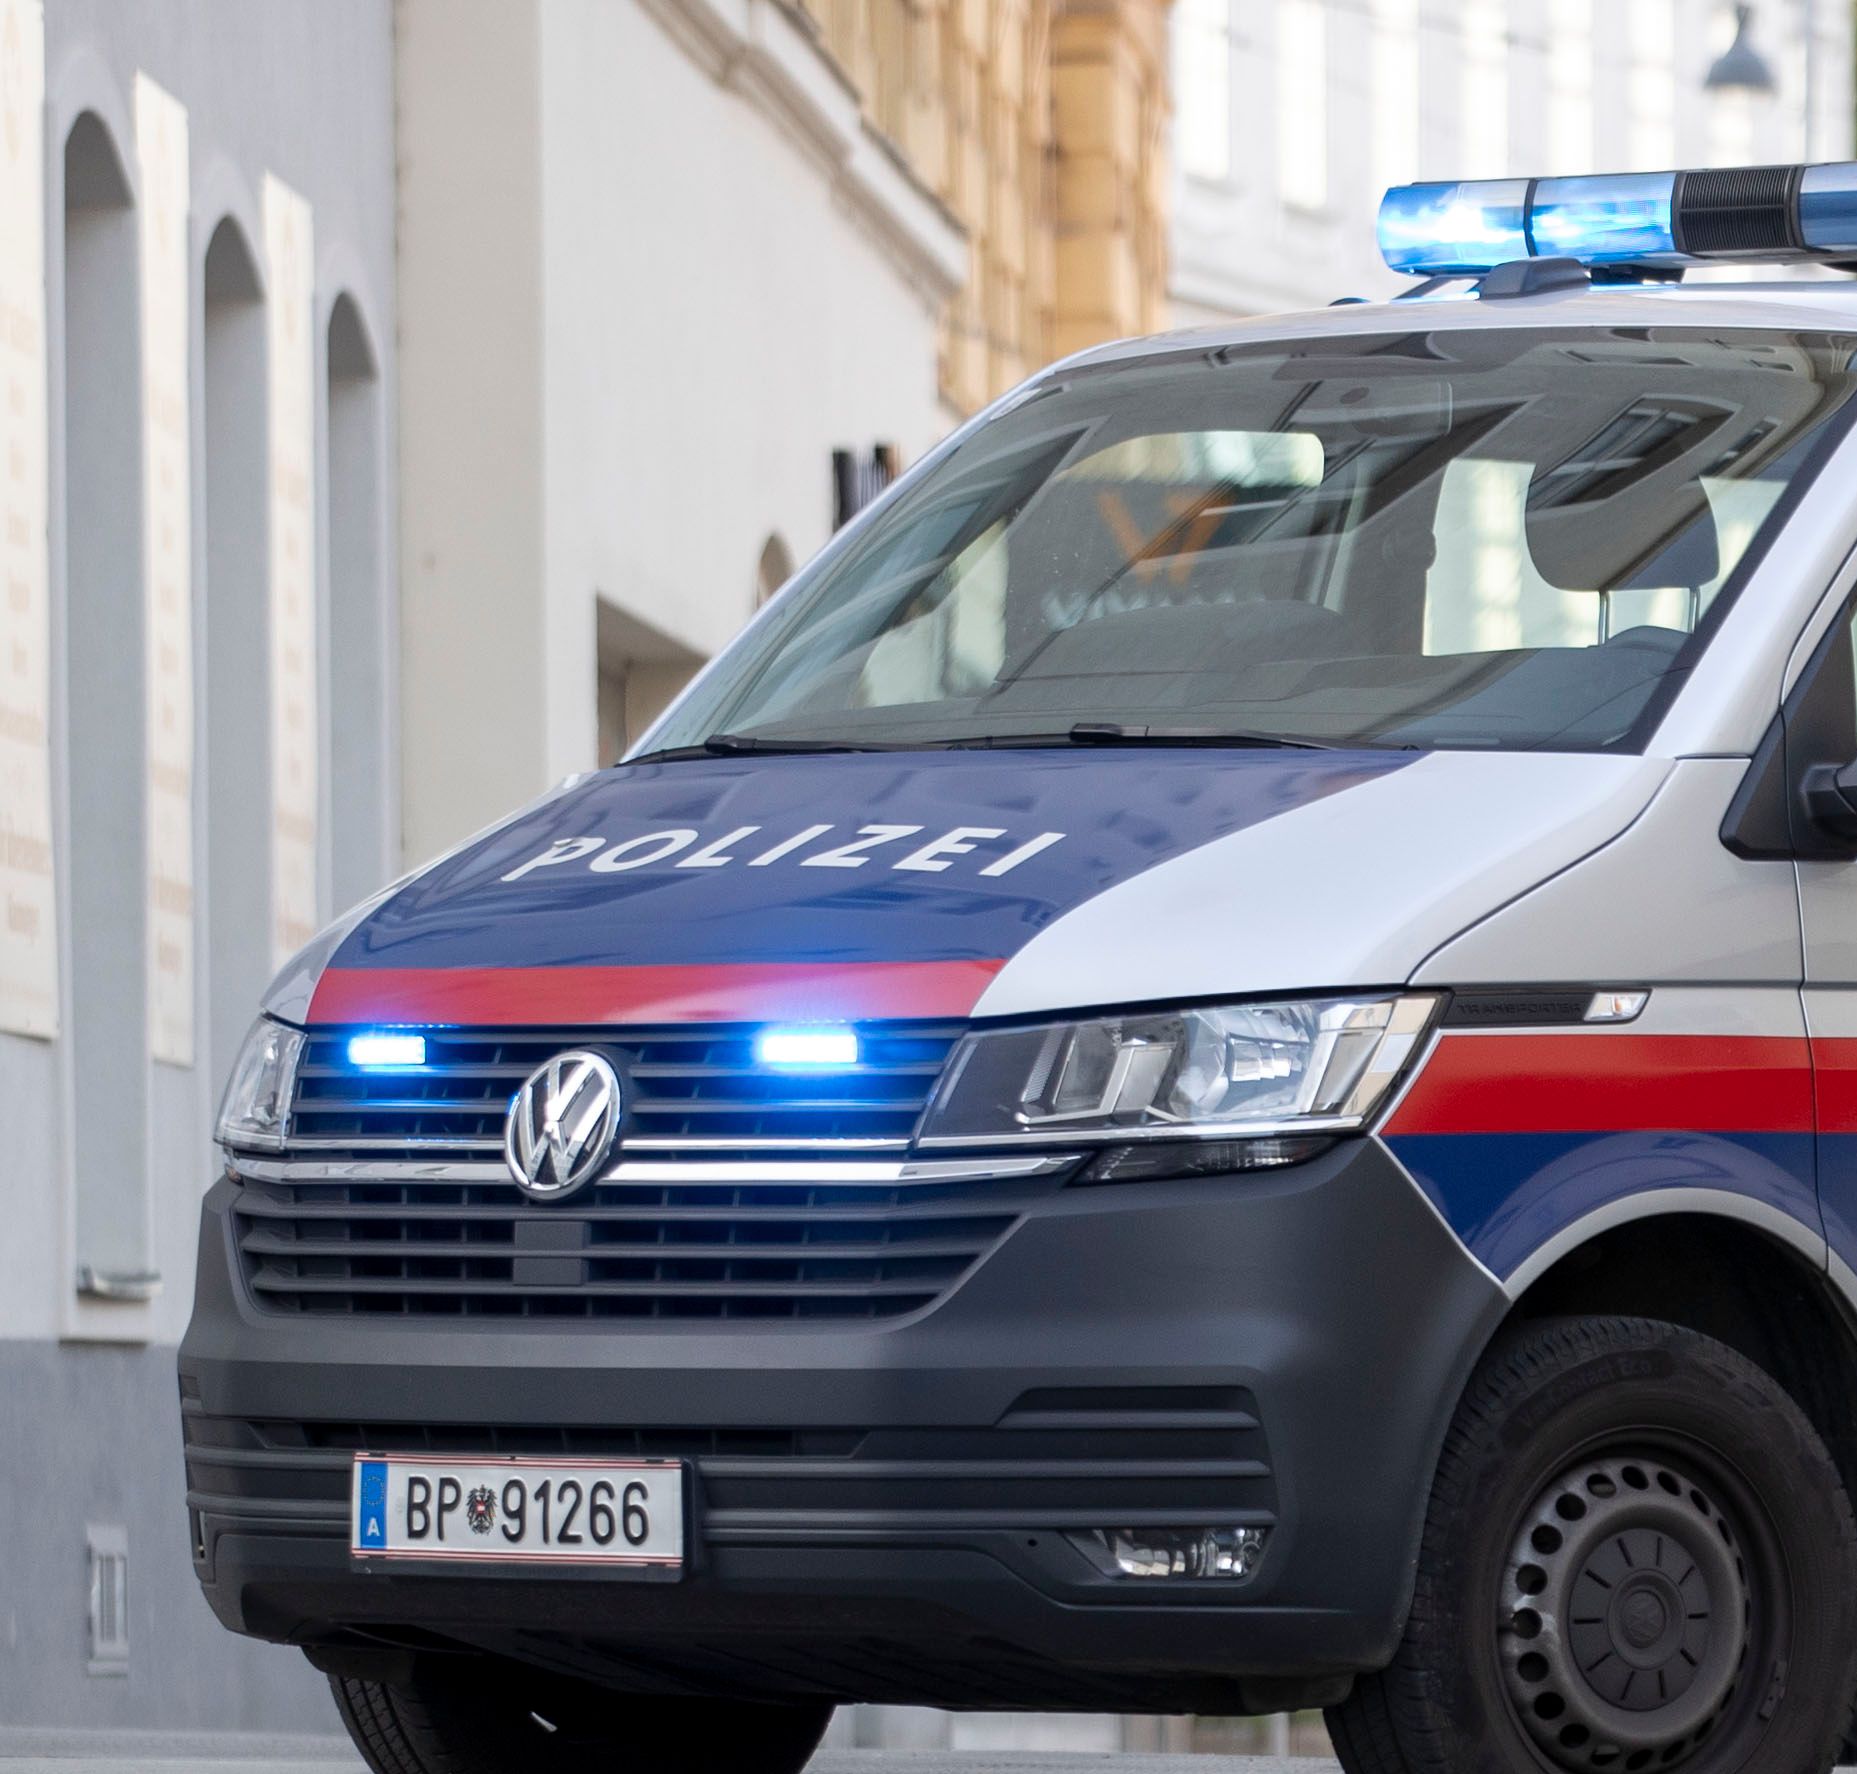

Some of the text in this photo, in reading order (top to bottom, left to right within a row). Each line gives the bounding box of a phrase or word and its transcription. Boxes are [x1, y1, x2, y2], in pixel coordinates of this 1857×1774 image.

[501, 824, 1067, 882] POLIZEI
[1456, 1002, 1583, 1016] TRANSPORTER
[366, 1517, 380, 1537] A
[406, 1476, 650, 1547] BP 91266
